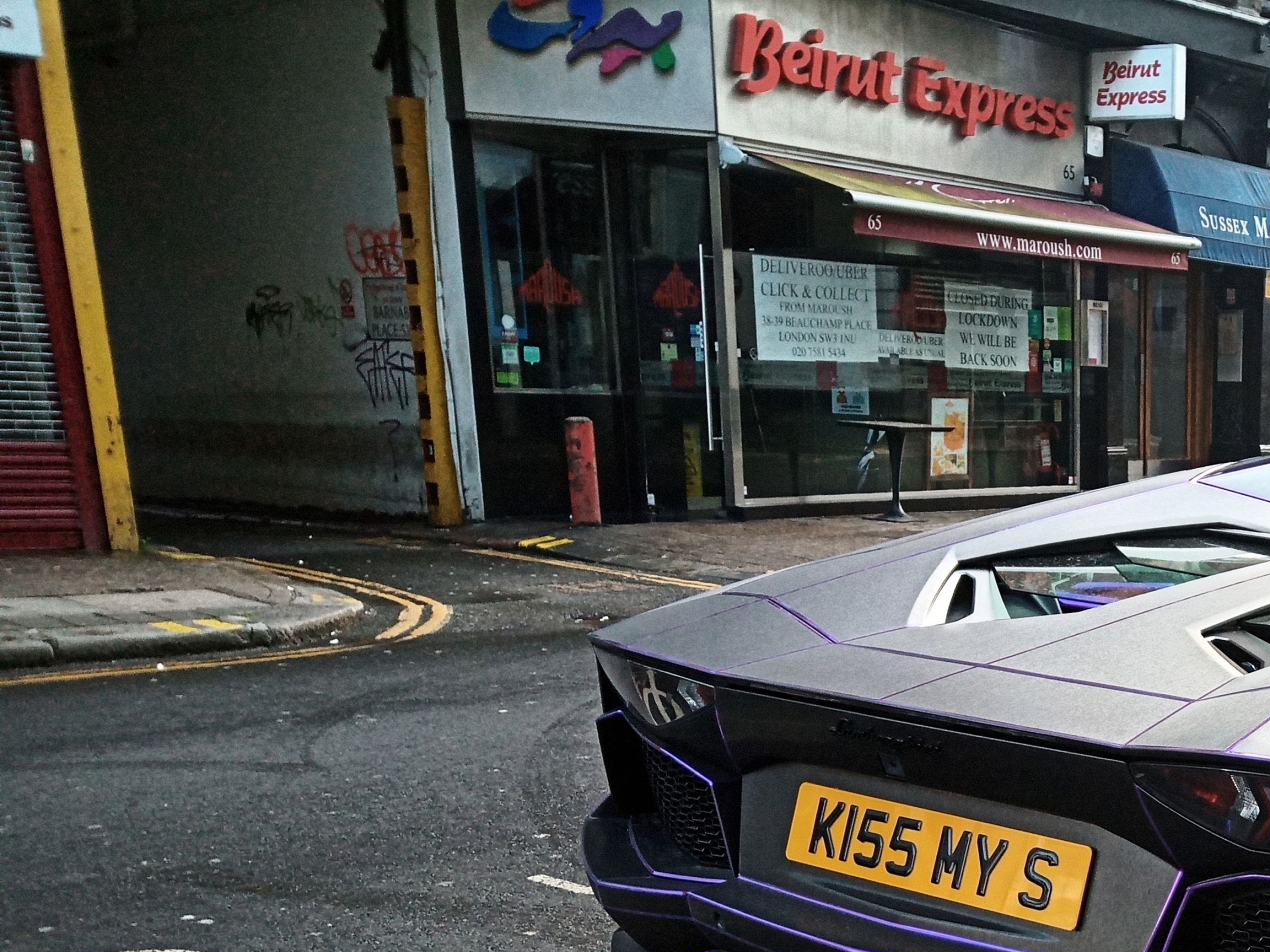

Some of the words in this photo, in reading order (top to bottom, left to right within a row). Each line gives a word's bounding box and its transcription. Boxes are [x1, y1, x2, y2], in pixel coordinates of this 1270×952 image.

[733, 13, 902, 104] Beirut
[904, 56, 1076, 138] Express
[1103, 60, 1161, 84] Beirut
[1096, 88, 1167, 110] Express
[1063, 165, 1076, 181] 65
[867, 214, 882, 231] 65
[976, 231, 1103, 261] www.maroush.com
[1171, 252, 1181, 265] 65
[761, 282, 797, 298] CLICK
[802, 286, 812, 299] &
[815, 287, 870, 302] COLLECT
[779, 301, 805, 312] FROM
[806, 304, 853, 314] MAROUSH
[948, 291, 986, 307] CLOSED
[987, 293, 1029, 311] DURING
[762, 316, 784, 326] 38-39
[785, 317, 843, 329] BEAUCHAMP
[844, 320, 872, 331] PLACE
[958, 312, 1018, 328] LOCKDOWN
[779, 331, 817, 343] LONDON
[819, 334, 838, 343] SW3
[959, 332, 975, 346] WE
[978, 334, 1002, 347] WILL
[1004, 336, 1017, 348] BE
[792, 346, 806, 357] 020
[808, 347, 826, 357] 7581
[828, 348, 846, 358] 5434
[960, 352, 988, 366] BACK
[990, 353, 1017, 367] SOON
[930, 826, 1009, 897] MY
[1017, 847, 1060, 911] S
